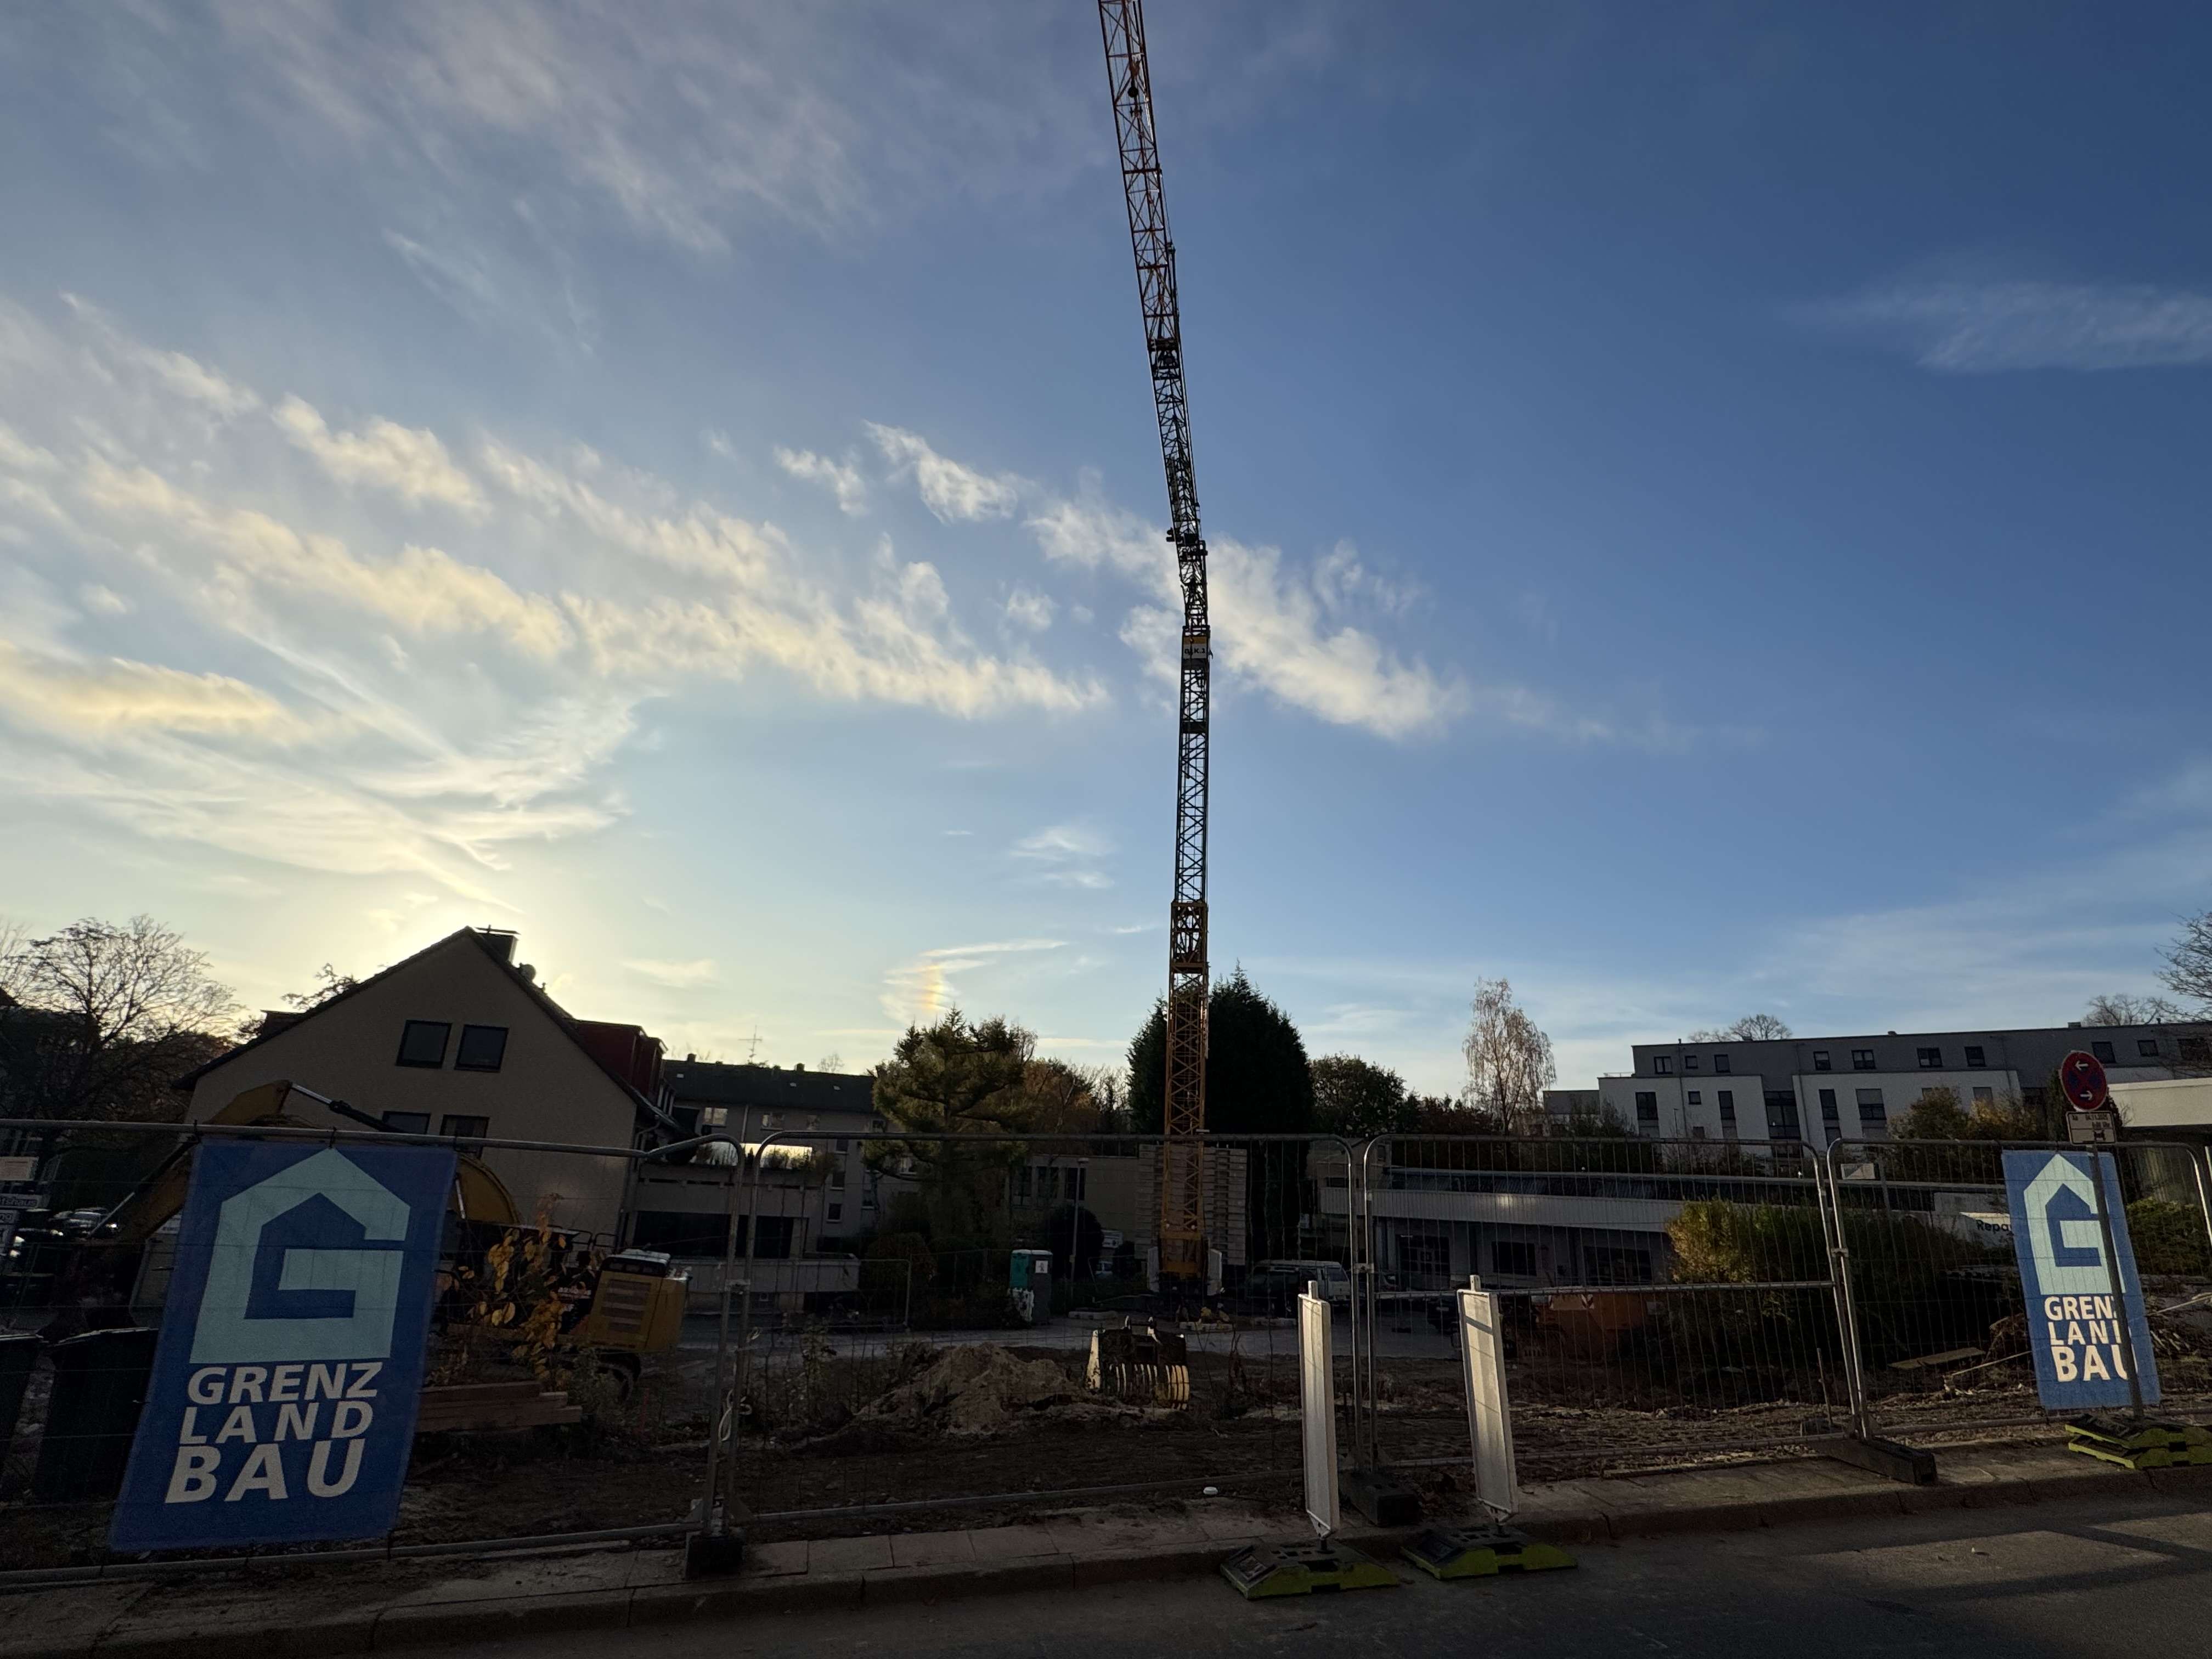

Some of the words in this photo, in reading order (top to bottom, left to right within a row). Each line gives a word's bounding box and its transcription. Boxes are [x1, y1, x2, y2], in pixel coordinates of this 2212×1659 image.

[1976, 1220, 2012, 1234] Repa
[2044, 1296, 2118, 1321] GREN
[188, 1362, 383, 1404] GRENZ
[2051, 1344, 2138, 1382] BAU
[179, 1401, 374, 1444] LAND
[165, 1439, 366, 1504] BAU
